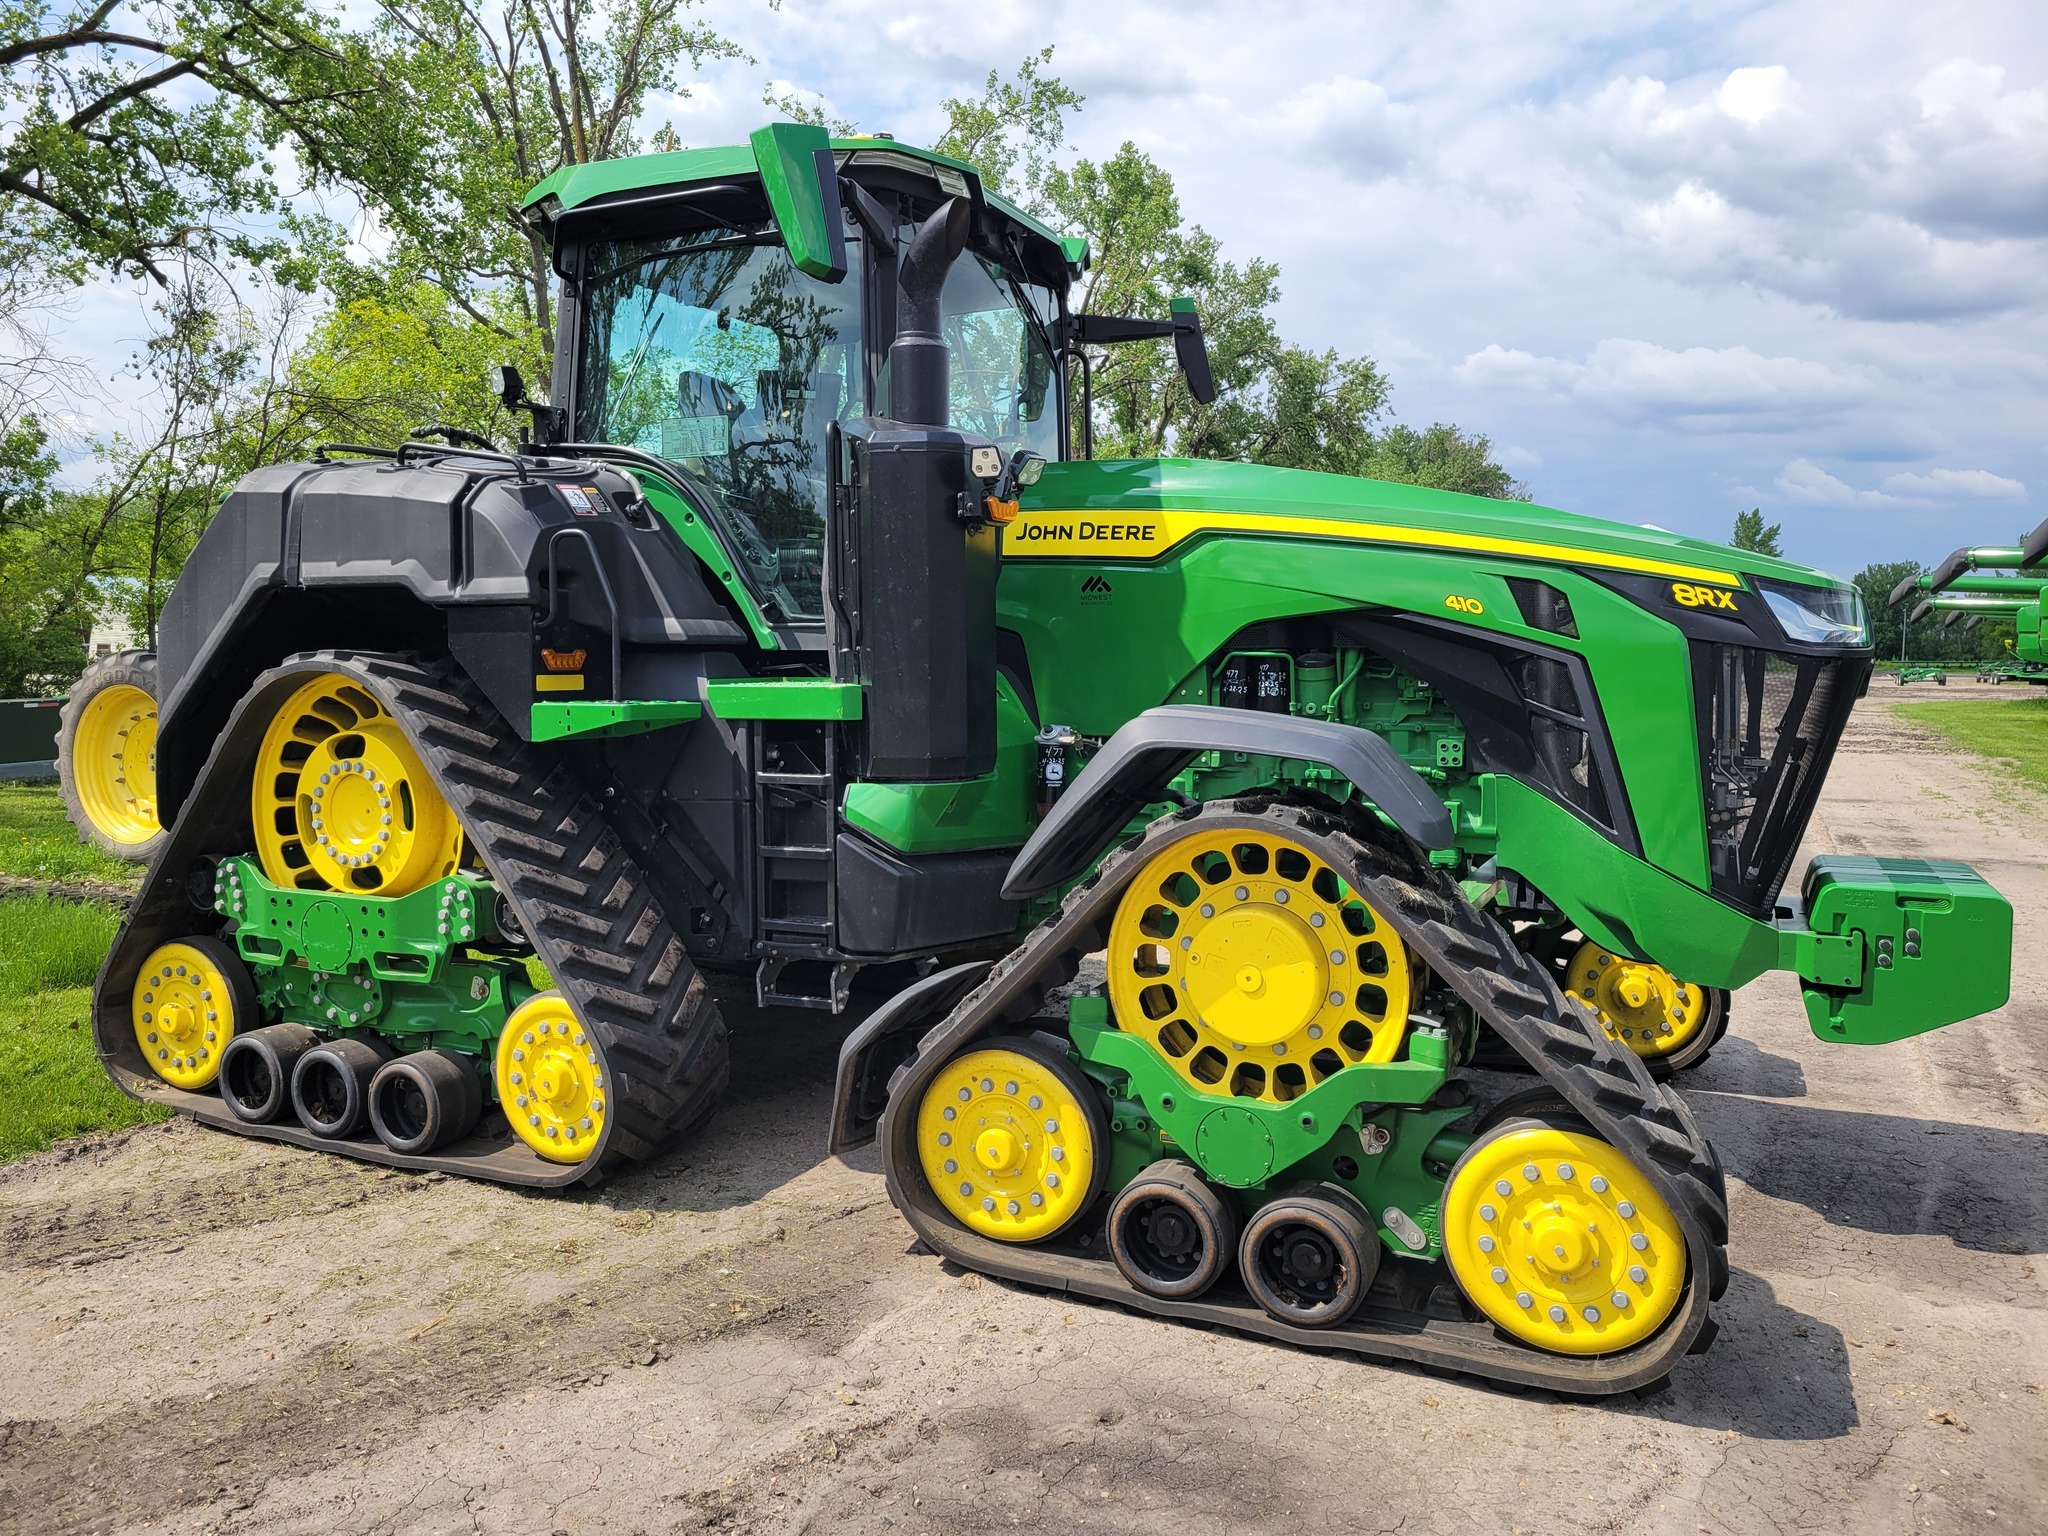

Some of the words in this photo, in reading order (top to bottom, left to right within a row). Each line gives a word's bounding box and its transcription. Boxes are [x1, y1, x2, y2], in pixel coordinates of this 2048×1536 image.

[1016, 522, 1074, 541] JOHN
[1079, 521, 1156, 541] DEERE
[1445, 594, 1485, 615] 410
[1671, 583, 1739, 611] 8RX
